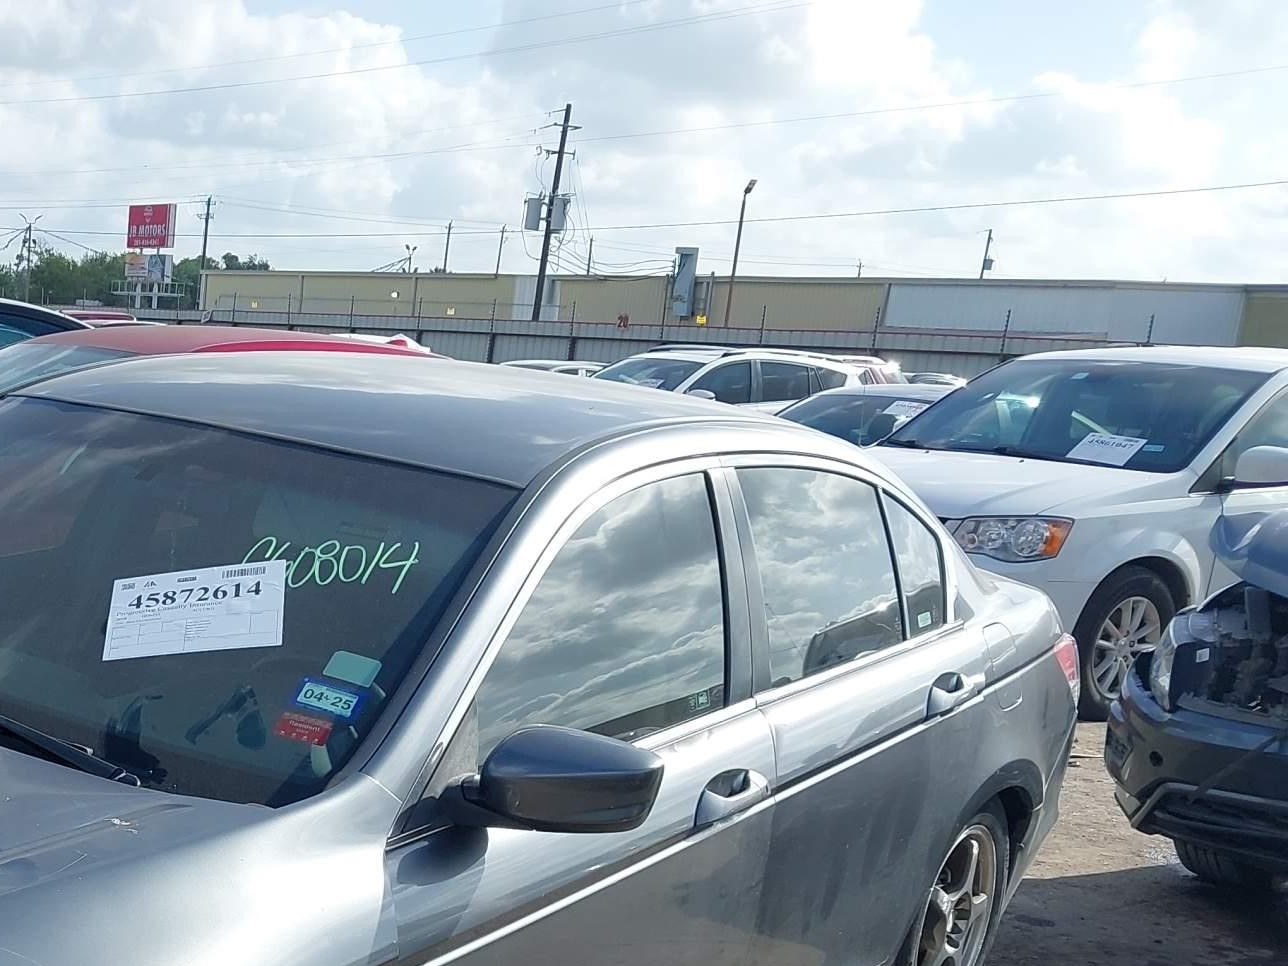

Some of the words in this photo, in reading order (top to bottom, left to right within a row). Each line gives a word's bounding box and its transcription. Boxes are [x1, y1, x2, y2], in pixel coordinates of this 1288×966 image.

[139, 223, 166, 237] MOTORS
[128, 580, 262, 609] 45872614
[330, 696, 353, 711] 25
